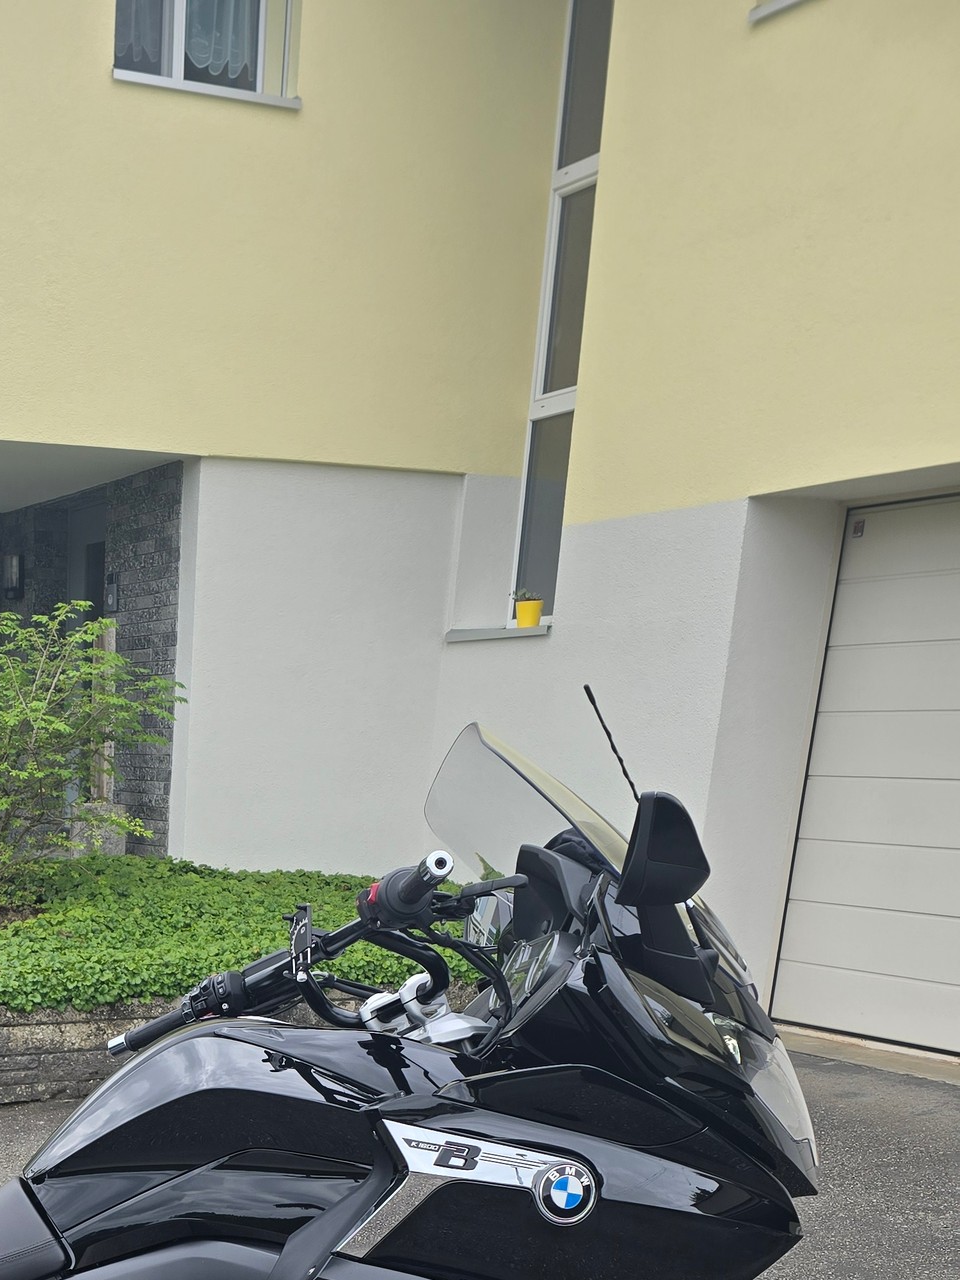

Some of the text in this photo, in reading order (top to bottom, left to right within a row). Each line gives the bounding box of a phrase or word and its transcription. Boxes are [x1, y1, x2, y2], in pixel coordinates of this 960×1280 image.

[418, 1142, 439, 1151] 1600
[433, 1140, 482, 1171] B
[548, 1166, 591, 1187] BMW
